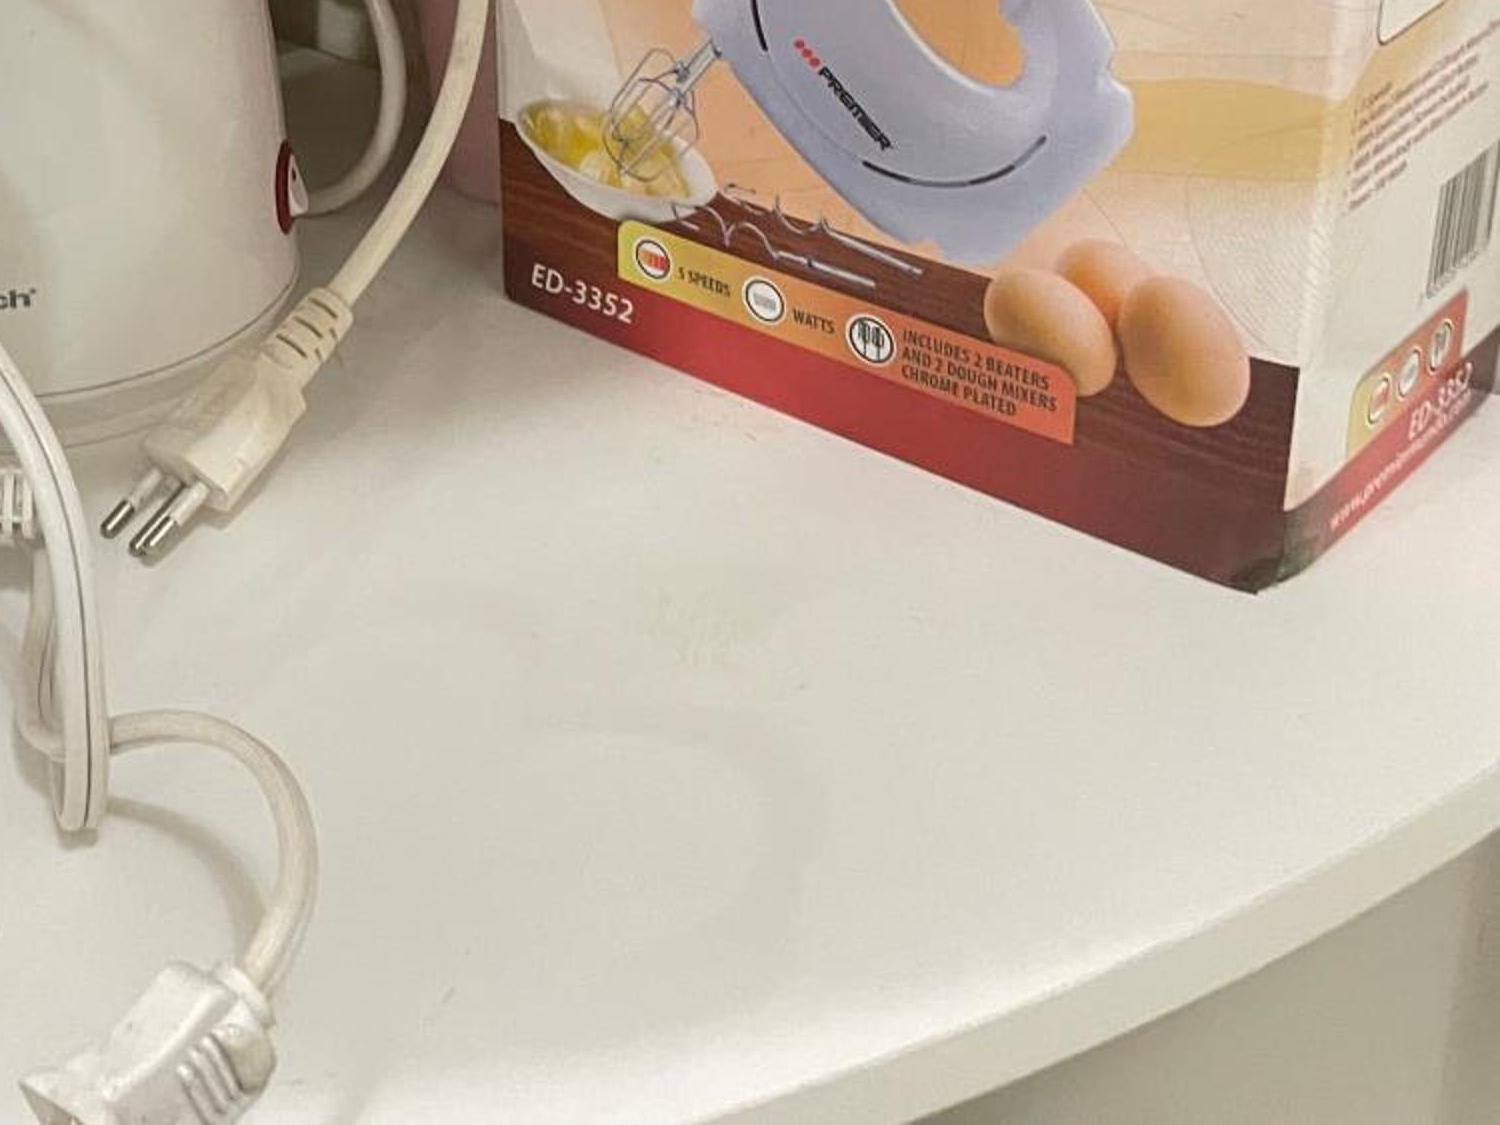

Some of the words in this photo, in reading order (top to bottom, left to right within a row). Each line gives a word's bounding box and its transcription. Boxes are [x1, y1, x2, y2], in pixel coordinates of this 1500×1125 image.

[818, 66, 892, 150] PREMIER
[530, 262, 635, 324] ED-3352
[687, 269, 731, 299] SPEEDS
[792, 307, 836, 335] WATTS
[902, 329, 970, 364] INCLUDES
[973, 351, 981, 367] 2
[986, 357, 1050, 391] BEATERS
[902, 347, 932, 368] AND
[935, 358, 943, 373] 2
[947, 363, 997, 392] DOUGH
[1001, 380, 1058, 413] MIXERS
[902, 365, 959, 397] CHROME
[963, 388, 1017, 418] PLATED
